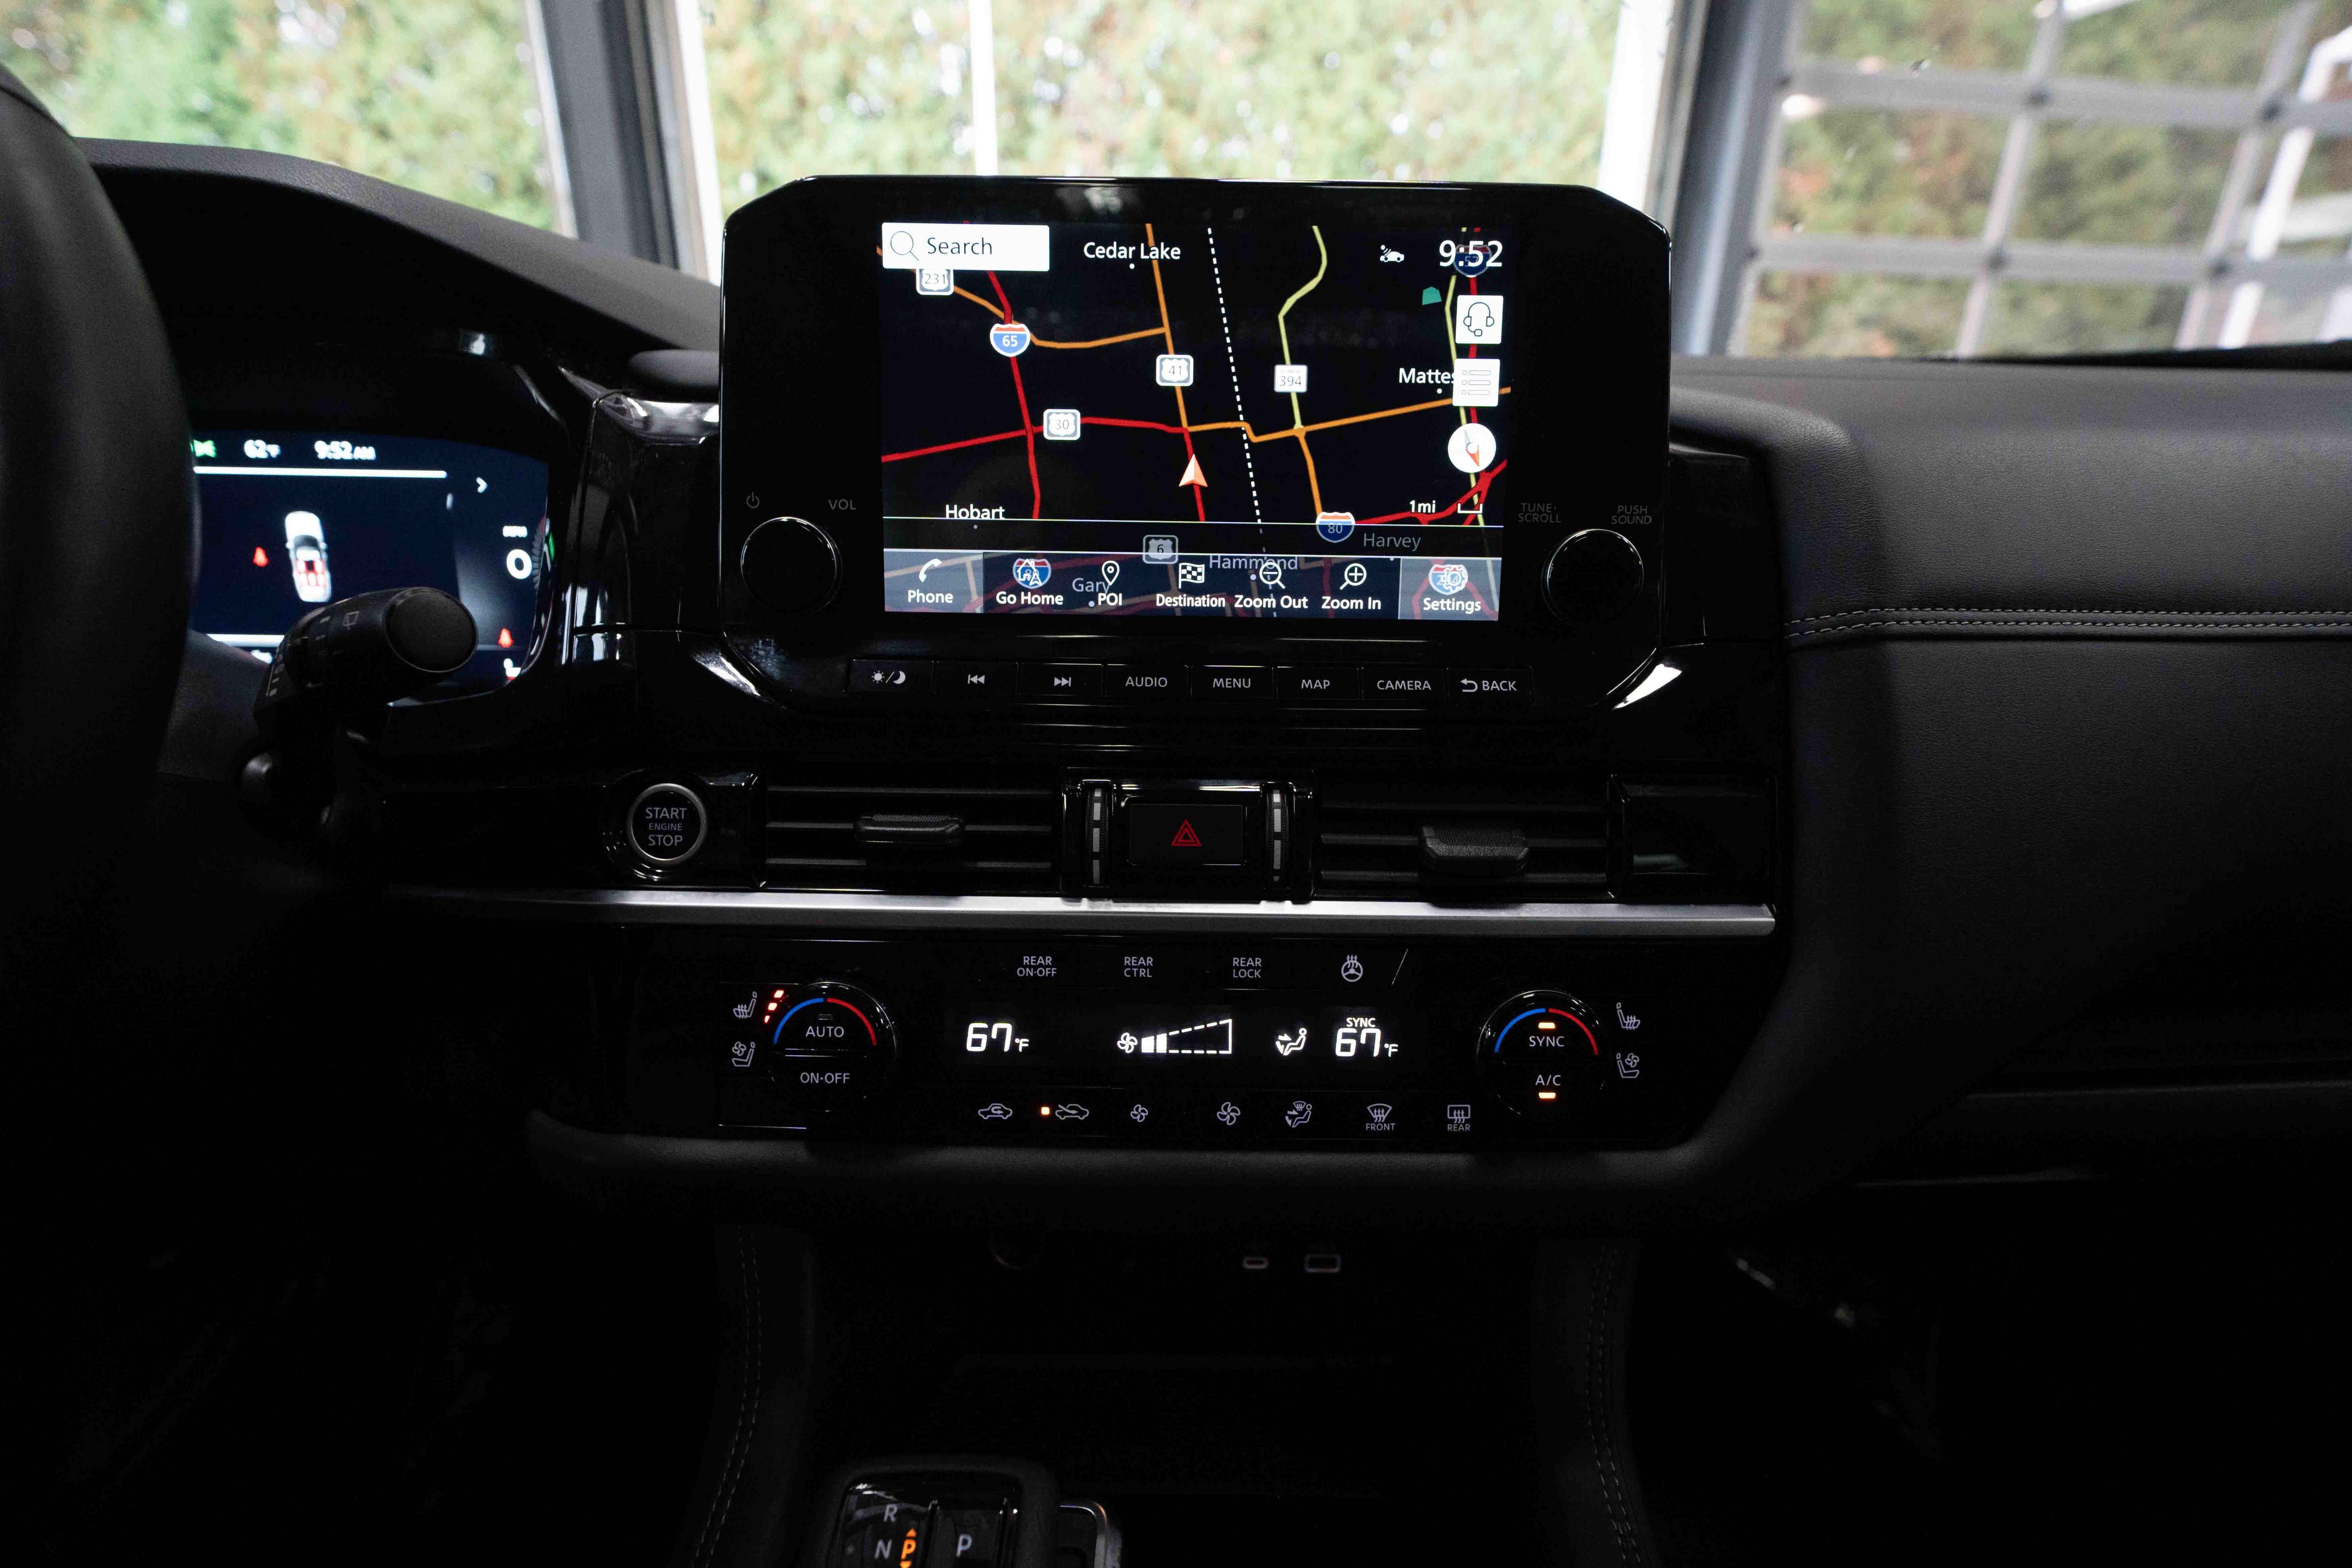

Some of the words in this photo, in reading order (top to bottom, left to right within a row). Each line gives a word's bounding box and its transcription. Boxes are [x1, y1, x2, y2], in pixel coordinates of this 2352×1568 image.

[927, 237, 993, 255] Search
[1083, 242, 1135, 259] Cedar
[1140, 243, 1181, 260] Lake
[1439, 240, 1503, 267] 9:52
[924, 273, 946, 285] 231
[1002, 335, 1018, 347] 65
[1169, 365, 1183, 376] 41
[1279, 375, 1302, 386] 394
[1056, 419, 1069, 430] 30
[828, 499, 856, 510] VOL
[1617, 505, 1648, 514] PUSH
[945, 504, 1005, 519] Hobart
[1518, 513, 1561, 523] SCROLL
[1611, 515, 1652, 525] SOUND
[1328, 523, 1343, 534] 80
[1364, 533, 1421, 551] Harvey
[1156, 544, 1164, 554] 6
[506, 549, 532, 579] 0
[1209, 556, 1298, 570] Hammond
[1072, 578, 1111, 593] Gary
[908, 589, 953, 604] Phone
[996, 591, 1017, 605] Go
[1021, 592, 1064, 606] Home
[1098, 593, 1123, 606] POI
[1156, 593, 1226, 608] Destination
[1234, 595, 1275, 609] Zoom
[1281, 595, 1308, 609] Out
[1322, 596, 1364, 610] Zoom
[1368, 597, 1381, 610] In
[1423, 597, 1482, 614] Settings
[1125, 676, 1168, 688] AUDIO
[1212, 677, 1251, 689] MENU
[1301, 679, 1330, 690] MAP
[1376, 679, 1432, 691] CAMERA
[1482, 680, 1517, 691] BACK
[645, 807, 687, 819] START
[648, 823, 682, 831] ENGINE
[648, 835, 683, 846] STOP
[1022, 956, 1052, 966] REAR
[1123, 956, 1154, 966] REAR
[1232, 957, 1262, 967] REAR
[1123, 967, 1153, 978] CTRL
[1232, 968, 1262, 978] LOCK
[1345, 1017, 1376, 1027] SYNC
[805, 1026, 844, 1038] AUTO
[1528, 1036, 1565, 1047] SYNC
[1535, 1074, 1561, 1086] A/C
[1365, 1123, 1396, 1131] FRONT
[1447, 1123, 1470, 1131] REAR
[883, 1503, 898, 1522] R
[874, 1539, 893, 1559] N
[901, 1539, 916, 1559] P
[956, 1533, 972, 1557] P
